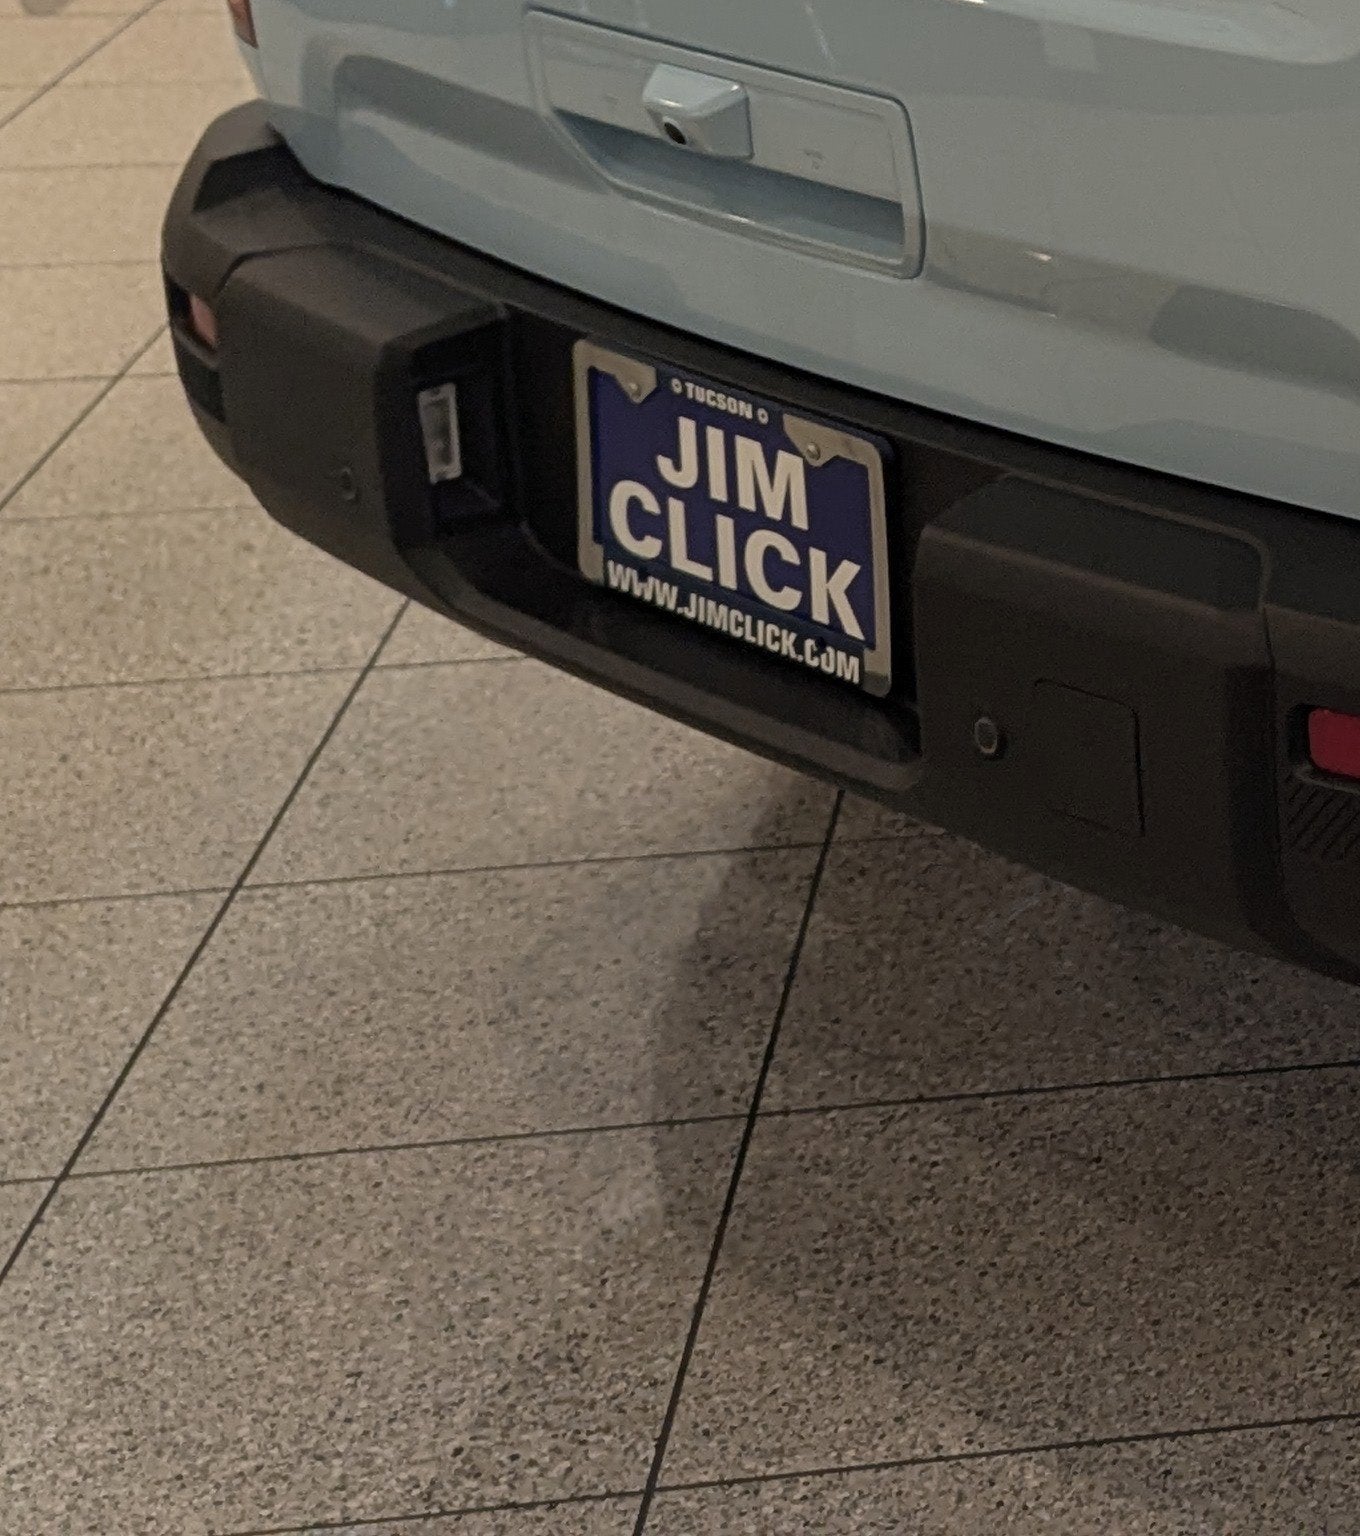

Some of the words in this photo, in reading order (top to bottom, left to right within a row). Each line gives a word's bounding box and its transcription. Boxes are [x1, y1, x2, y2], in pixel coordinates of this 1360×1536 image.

[684, 382, 753, 420] TUCSON
[657, 415, 809, 531] JIM
[608, 479, 865, 642] CLICK
[607, 560, 861, 684] WWW.JIMCLICK.COM
